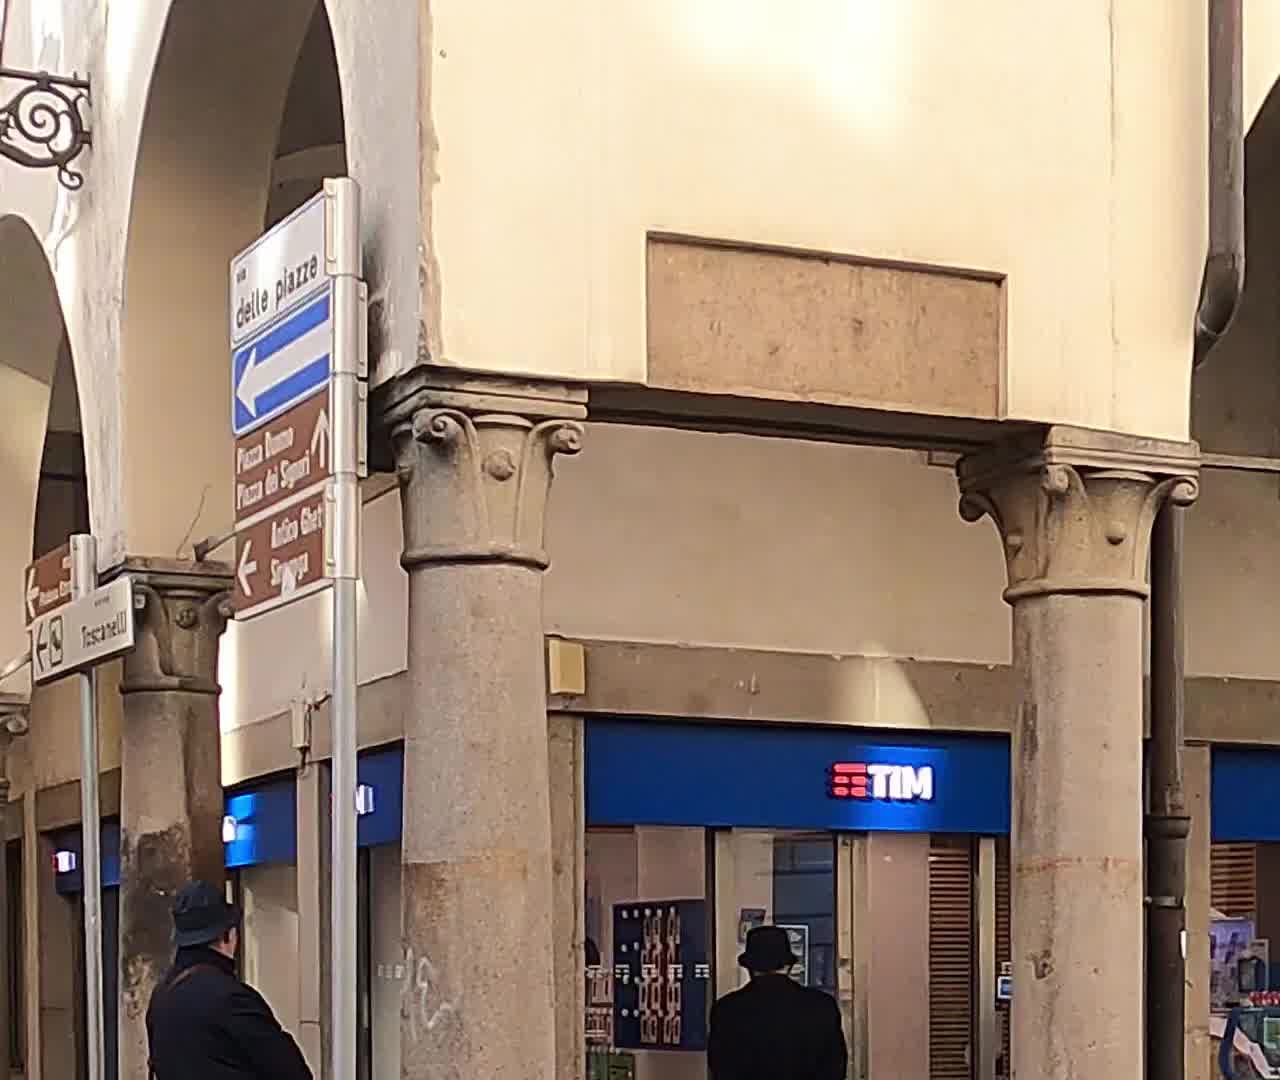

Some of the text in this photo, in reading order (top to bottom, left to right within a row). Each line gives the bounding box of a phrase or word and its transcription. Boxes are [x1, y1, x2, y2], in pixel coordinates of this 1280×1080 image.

[236, 255, 318, 329] delle piazze
[867, 764, 933, 800] TIM
